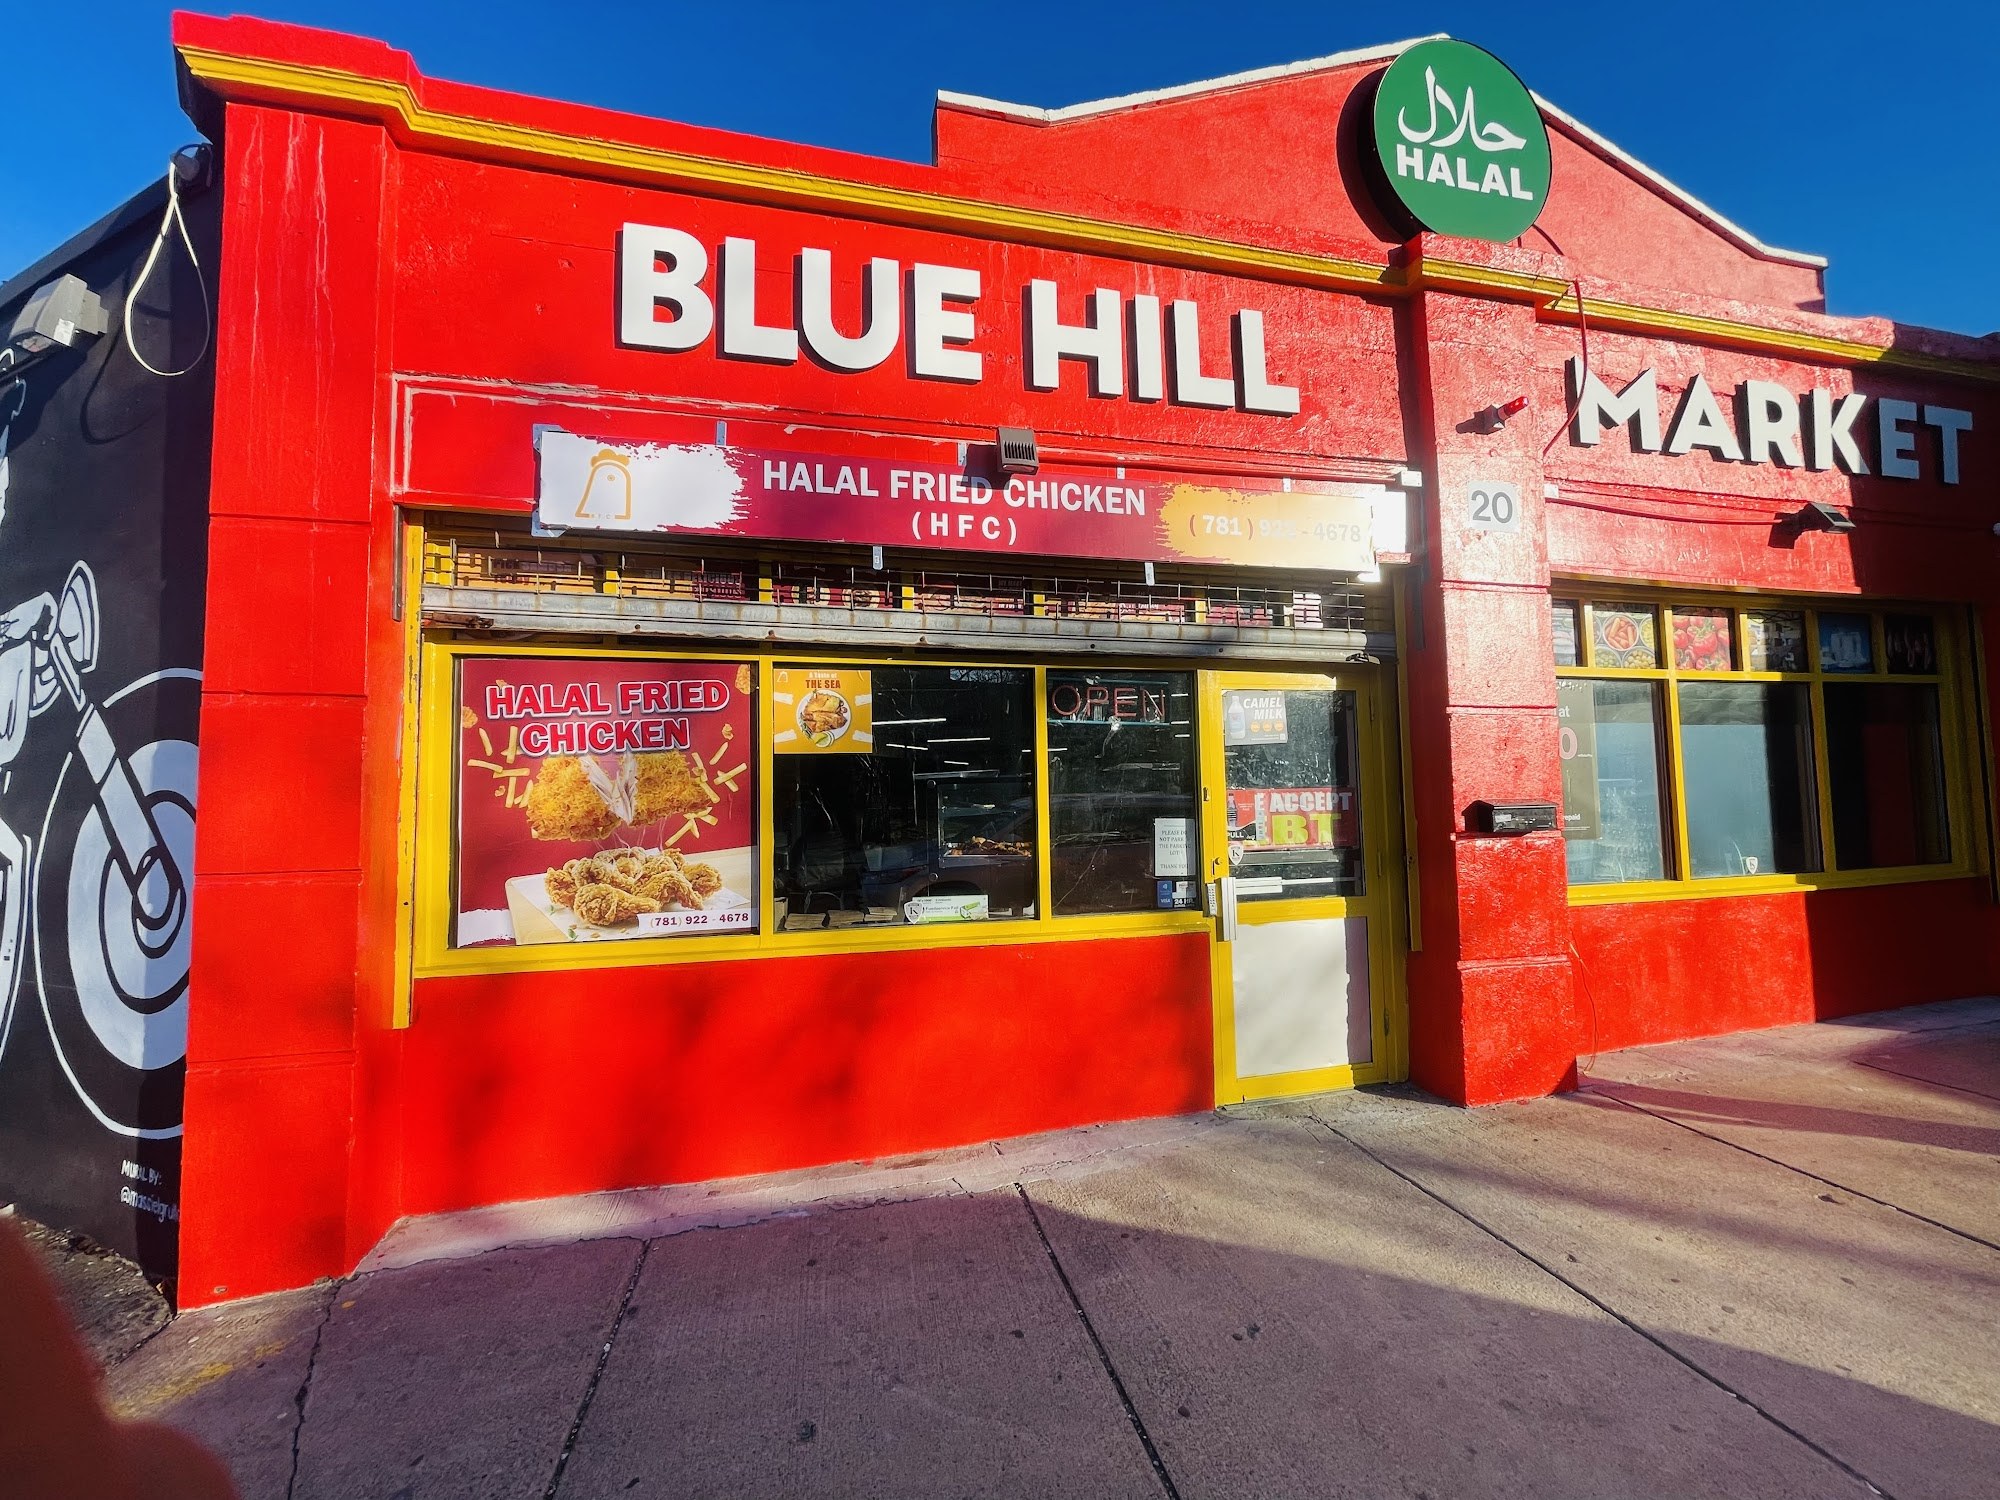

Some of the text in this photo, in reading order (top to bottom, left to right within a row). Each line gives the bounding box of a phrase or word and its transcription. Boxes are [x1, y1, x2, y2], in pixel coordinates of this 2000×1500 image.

[1397, 65, 1527, 152] حلال
[1396, 144, 1533, 201] HALAL
[621, 222, 1301, 415] BLUE HILL
[1574, 355, 1974, 485] MARKET
[763, 459, 1146, 516] HALAL FRIED CHICKEN
[1471, 490, 1514, 526] 20
[1313, 522, 1361, 543] 4678
[486, 680, 730, 720] HALAL FRIED
[805, 680, 841, 689] THE SEA
[1052, 685, 1166, 718] OPEN
[1243, 697, 1282, 709] CAMEL
[1254, 709, 1283, 720] MILK
[520, 717, 691, 758] CHICKEN
[1270, 791, 1353, 813] ACCEPT
[1227, 831, 1244, 839] PULL
[685, 915, 708, 925] 922
[719, 912, 749, 923] 4678
